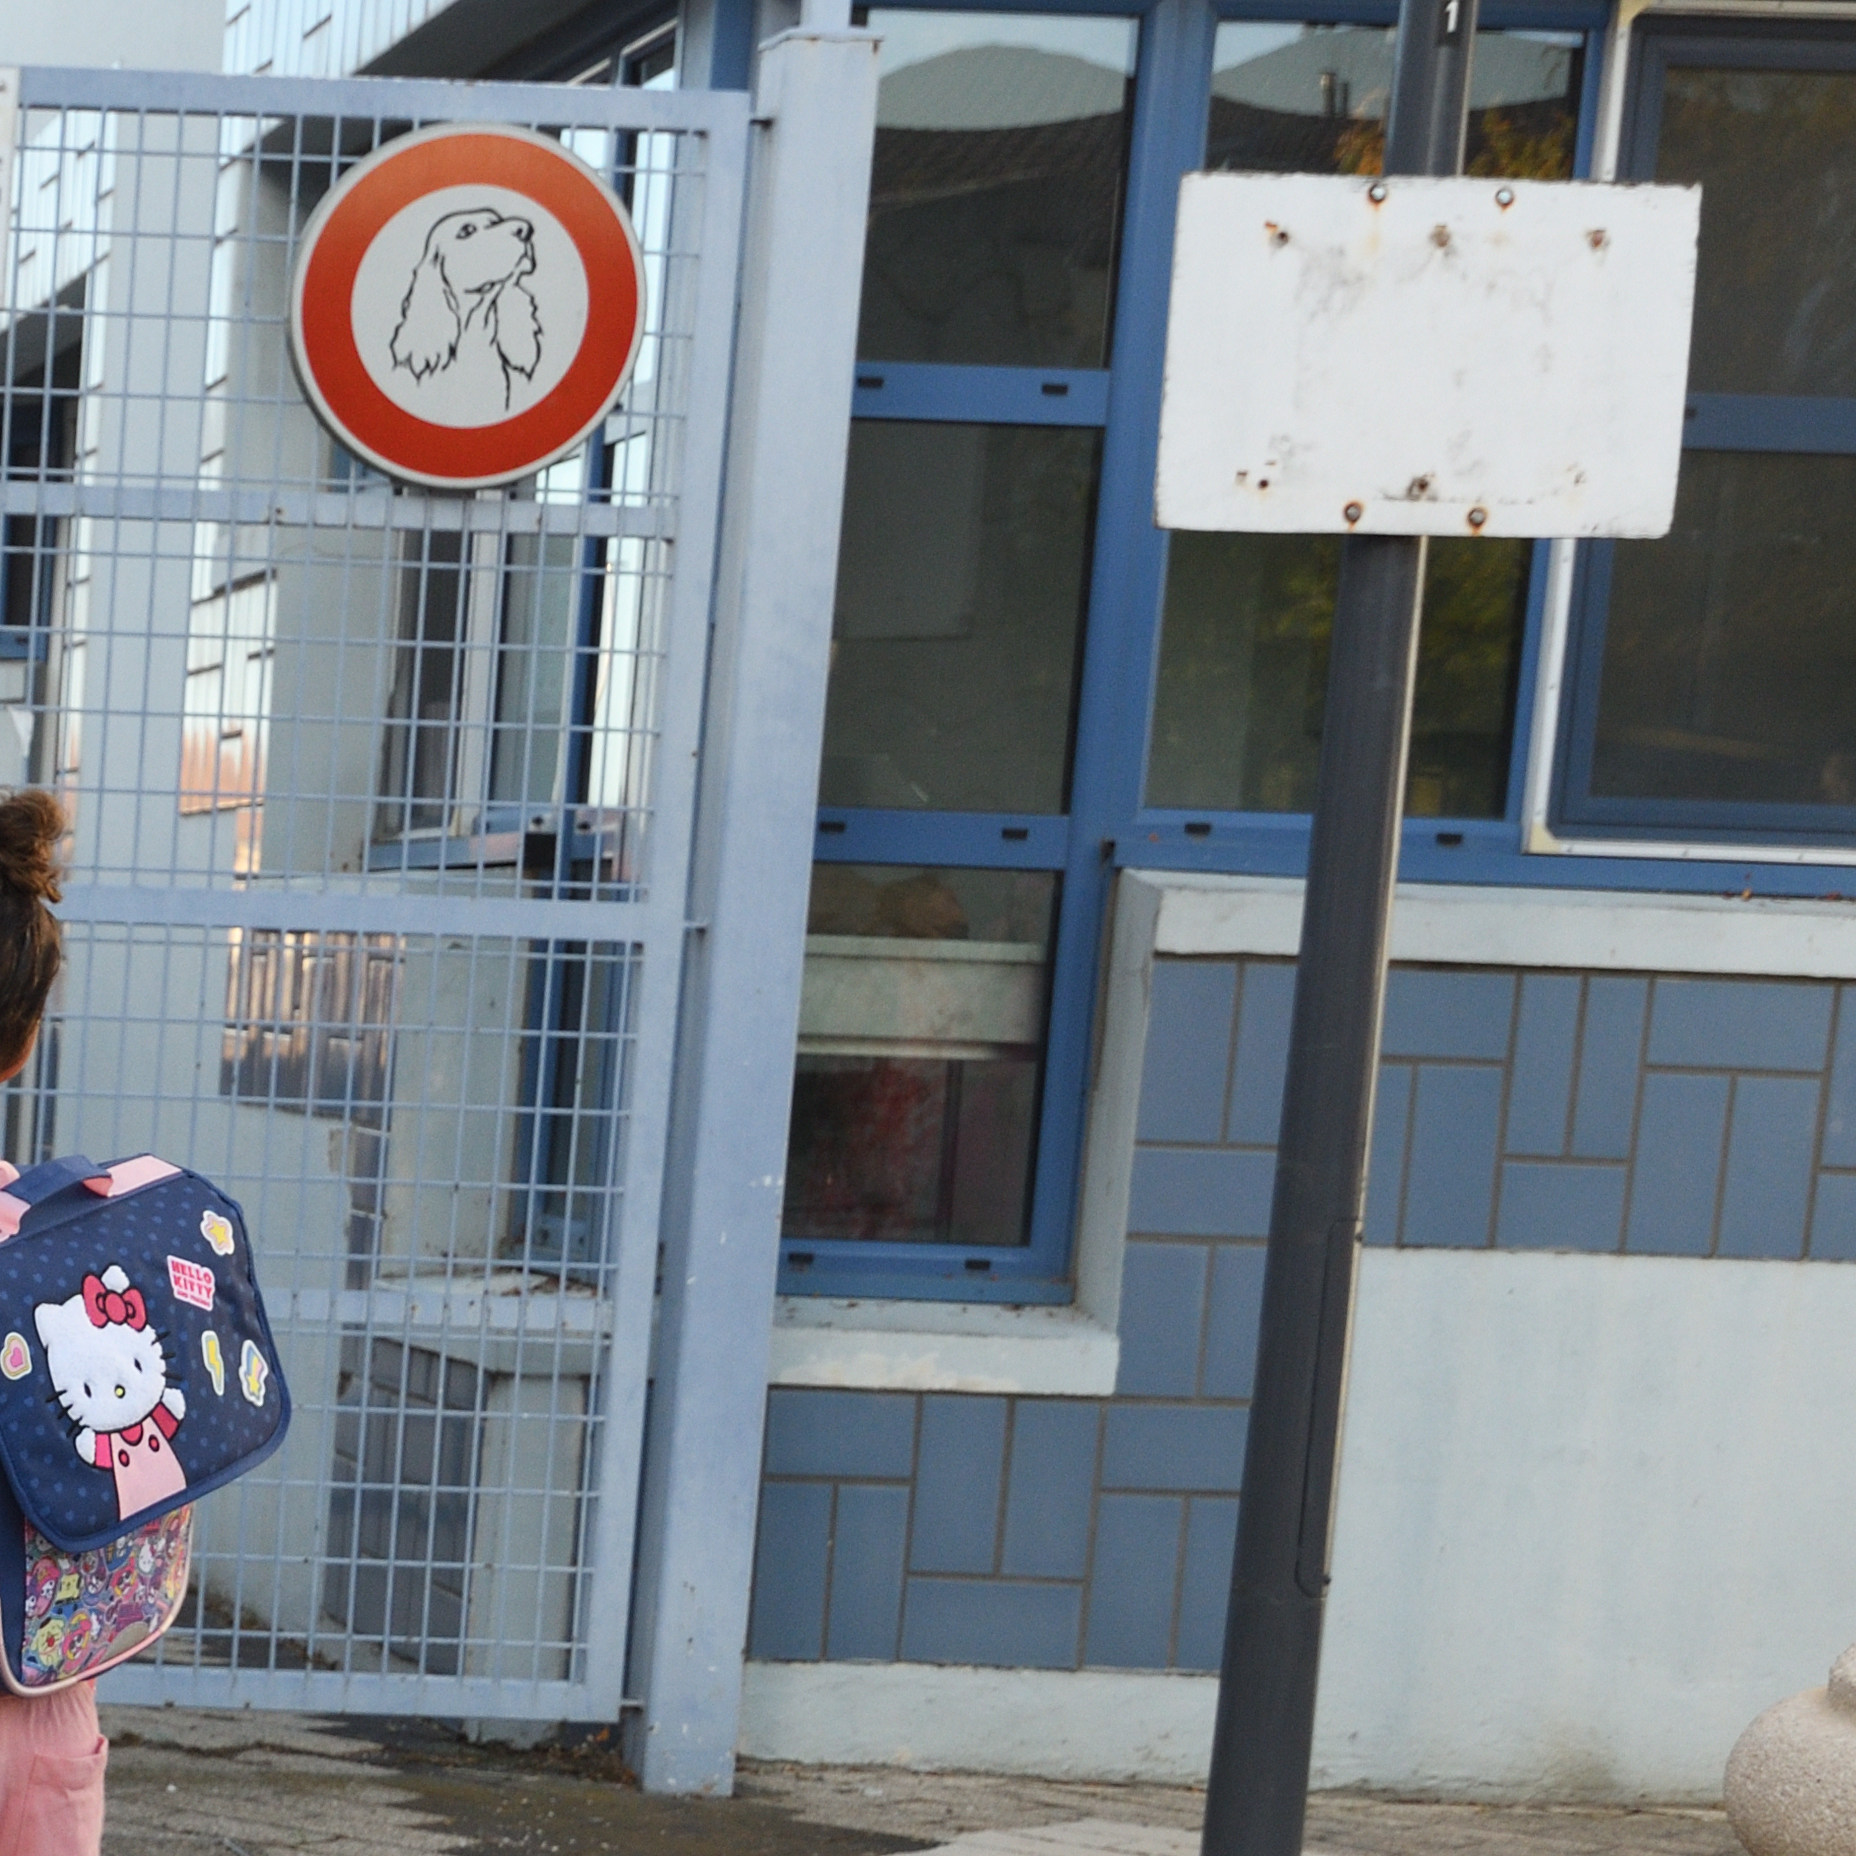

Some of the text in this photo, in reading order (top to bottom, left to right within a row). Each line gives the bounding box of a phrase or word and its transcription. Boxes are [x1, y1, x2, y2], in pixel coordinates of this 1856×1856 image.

[1445, 0, 1459, 33] 1
[171, 1260, 212, 1285] HELLO
[173, 1274, 213, 1300] KITTY
